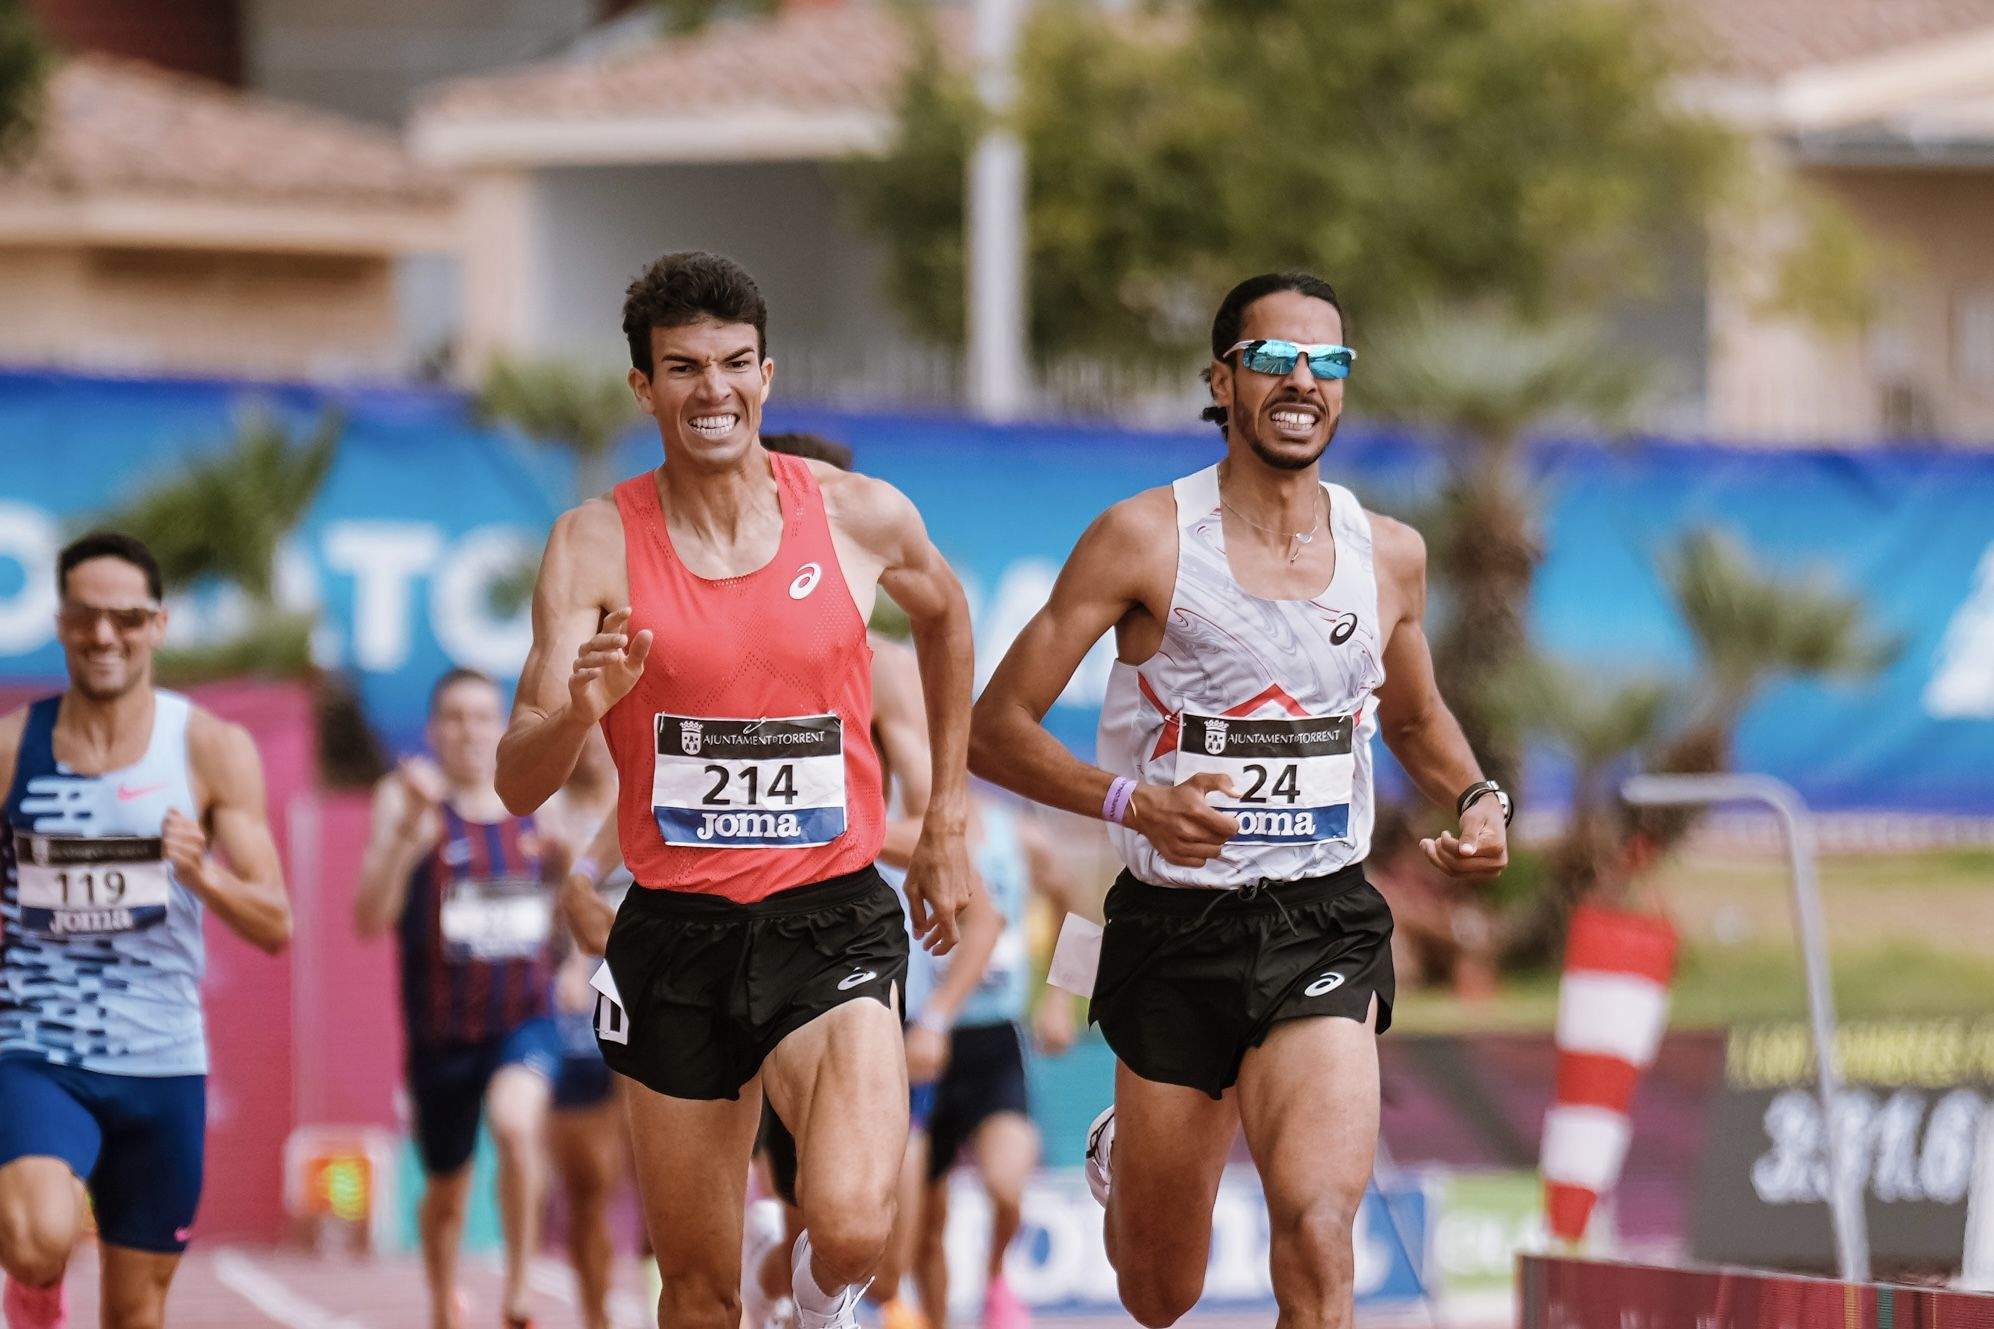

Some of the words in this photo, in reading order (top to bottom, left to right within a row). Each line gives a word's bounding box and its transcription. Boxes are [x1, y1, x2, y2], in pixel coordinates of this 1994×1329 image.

[702, 734, 772, 746] AJUNTAMENT
[778, 731, 825, 745] TORRENT
[1227, 733, 1294, 745] AJUNTAMENT
[1299, 730, 1340, 745] TORRENT
[701, 763, 799, 806] 214
[1238, 763, 1301, 804] 24
[696, 812, 802, 840] Joma
[1222, 811, 1316, 836] oma
[55, 871, 126, 905] 119
